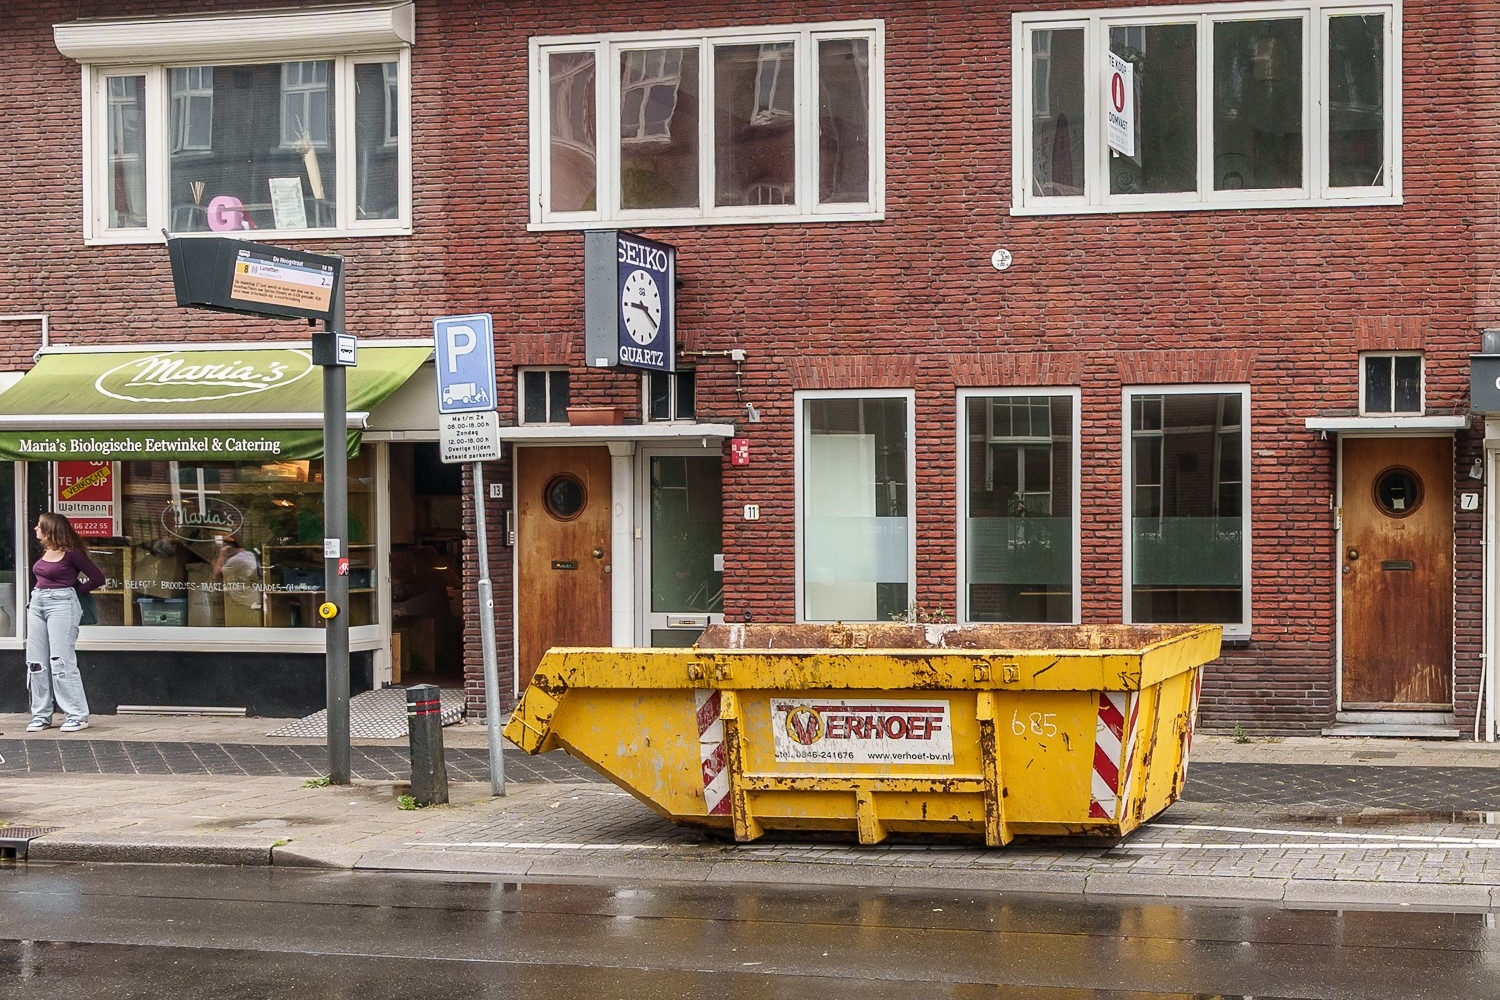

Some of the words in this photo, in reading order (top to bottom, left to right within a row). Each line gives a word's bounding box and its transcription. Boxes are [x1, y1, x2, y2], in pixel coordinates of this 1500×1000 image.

[1115, 59, 1127, 74] KOOP
[1109, 112, 1128, 131] DOMVAST
[618, 238, 668, 273] SEIKO
[244, 264, 249, 273] 8
[321, 277, 326, 286] 2
[446, 325, 477, 373] P
[620, 345, 664, 367] QUARTZ
[131, 356, 289, 383] Maria's
[447, 422, 485, 430] 08.00-18.00
[19, 437, 67, 453] Maria's
[69, 437, 143, 455] Biologische
[145, 437, 209, 452] Eetwinkel
[211, 438, 223, 452] &
[225, 437, 281, 454] Catering
[448, 437, 484, 445] 12.00-18.00
[472, 444, 491, 452] tijden
[59, 476, 72, 486] TE
[76, 476, 108, 487] KOP
[67, 469, 105, 495] VERKOCHT
[493, 485, 501, 496] 13
[58, 503, 107, 512] Waltmann
[1464, 495, 1474, 508] 7
[169, 505, 235, 526] Maria's
[747, 506, 756, 519] 11
[788, 704, 944, 746] VERHOEF
[1011, 708, 1057, 737] 685
[867, 751, 951, 761] www.verhoef-bv.nl
